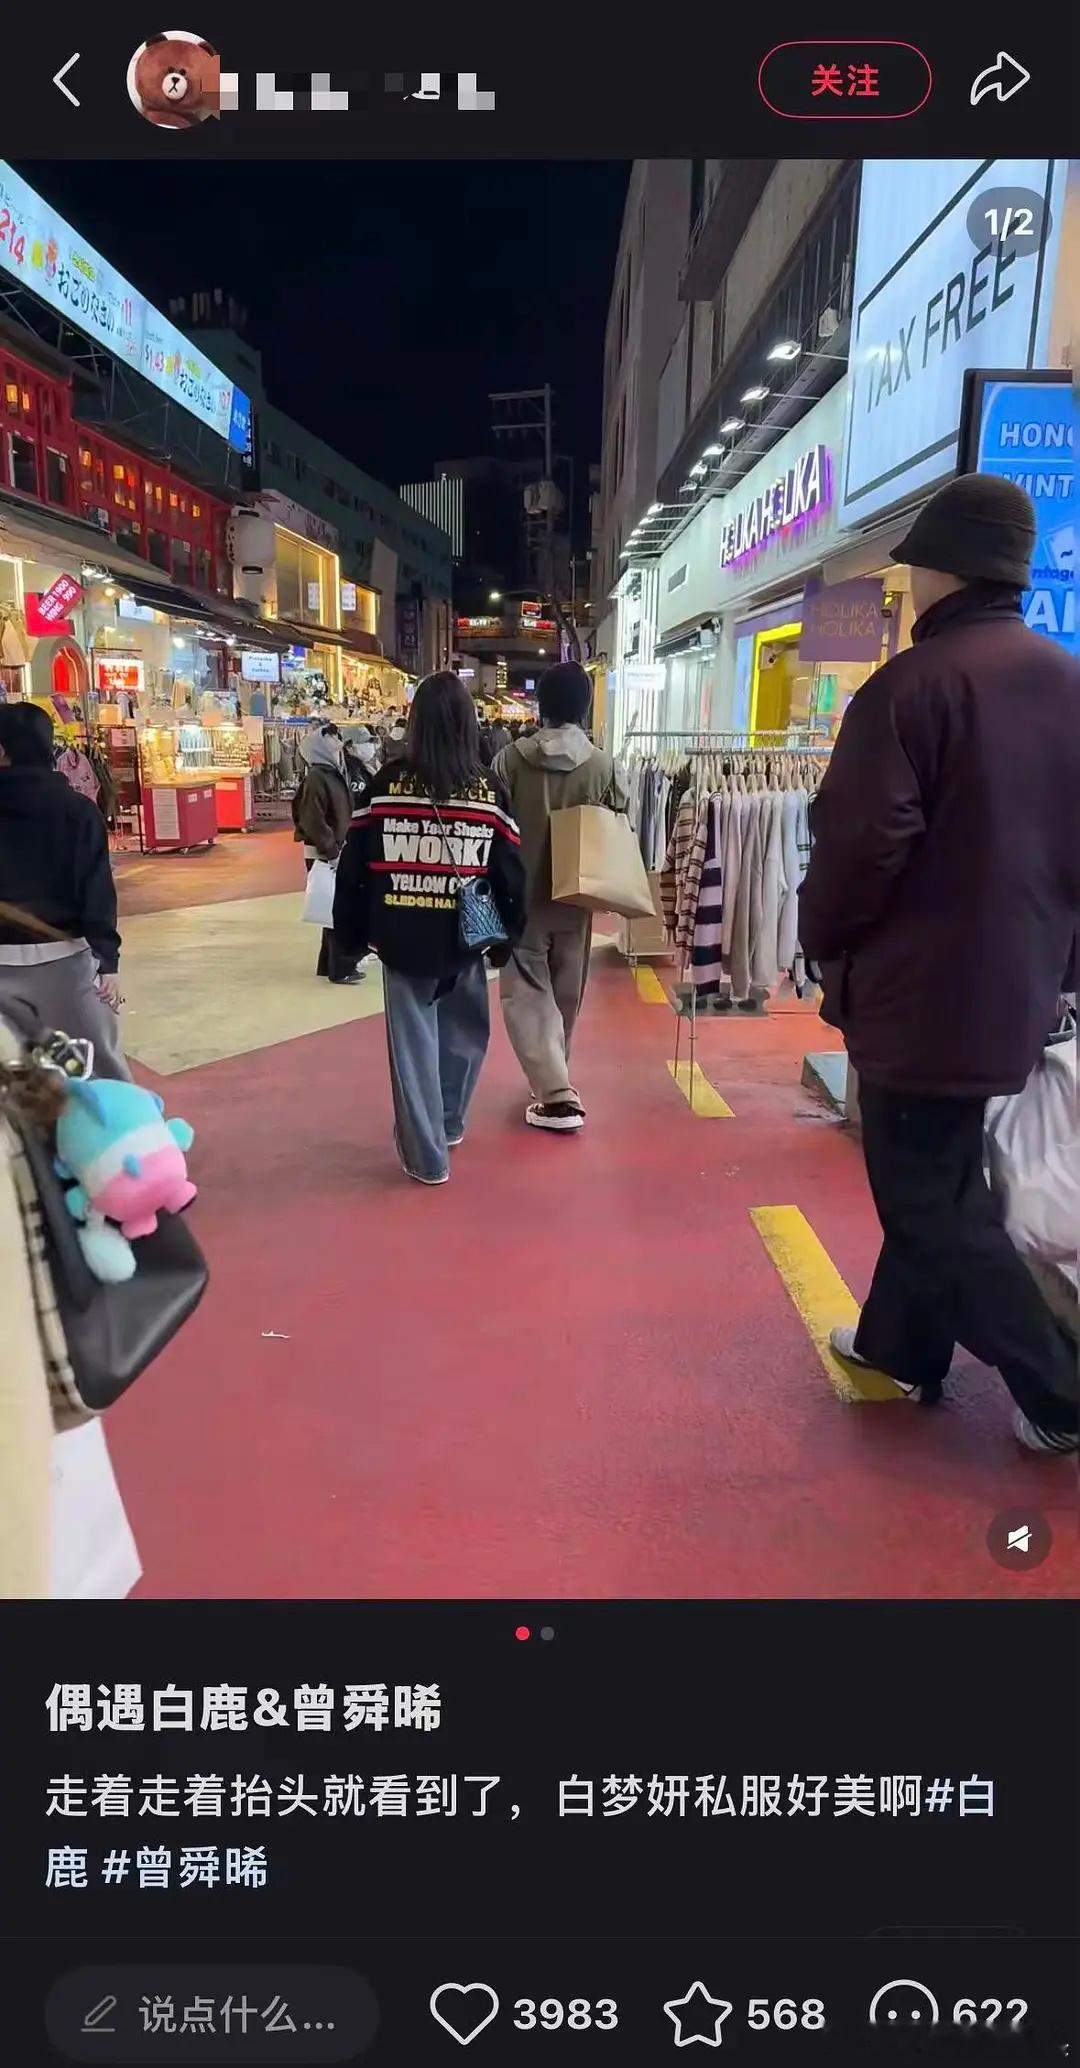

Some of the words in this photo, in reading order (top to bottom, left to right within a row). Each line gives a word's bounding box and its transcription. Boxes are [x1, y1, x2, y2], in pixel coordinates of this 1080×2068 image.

[867, 315, 917, 413] TAX
[922, 214, 1021, 369] FREE
[383, 818, 419, 834] Make
[421, 820, 451, 836] Your
[453, 821, 495, 839] Shocks
[382, 833, 493, 867] WORK!
[384, 894, 433, 909] SLEDGE
